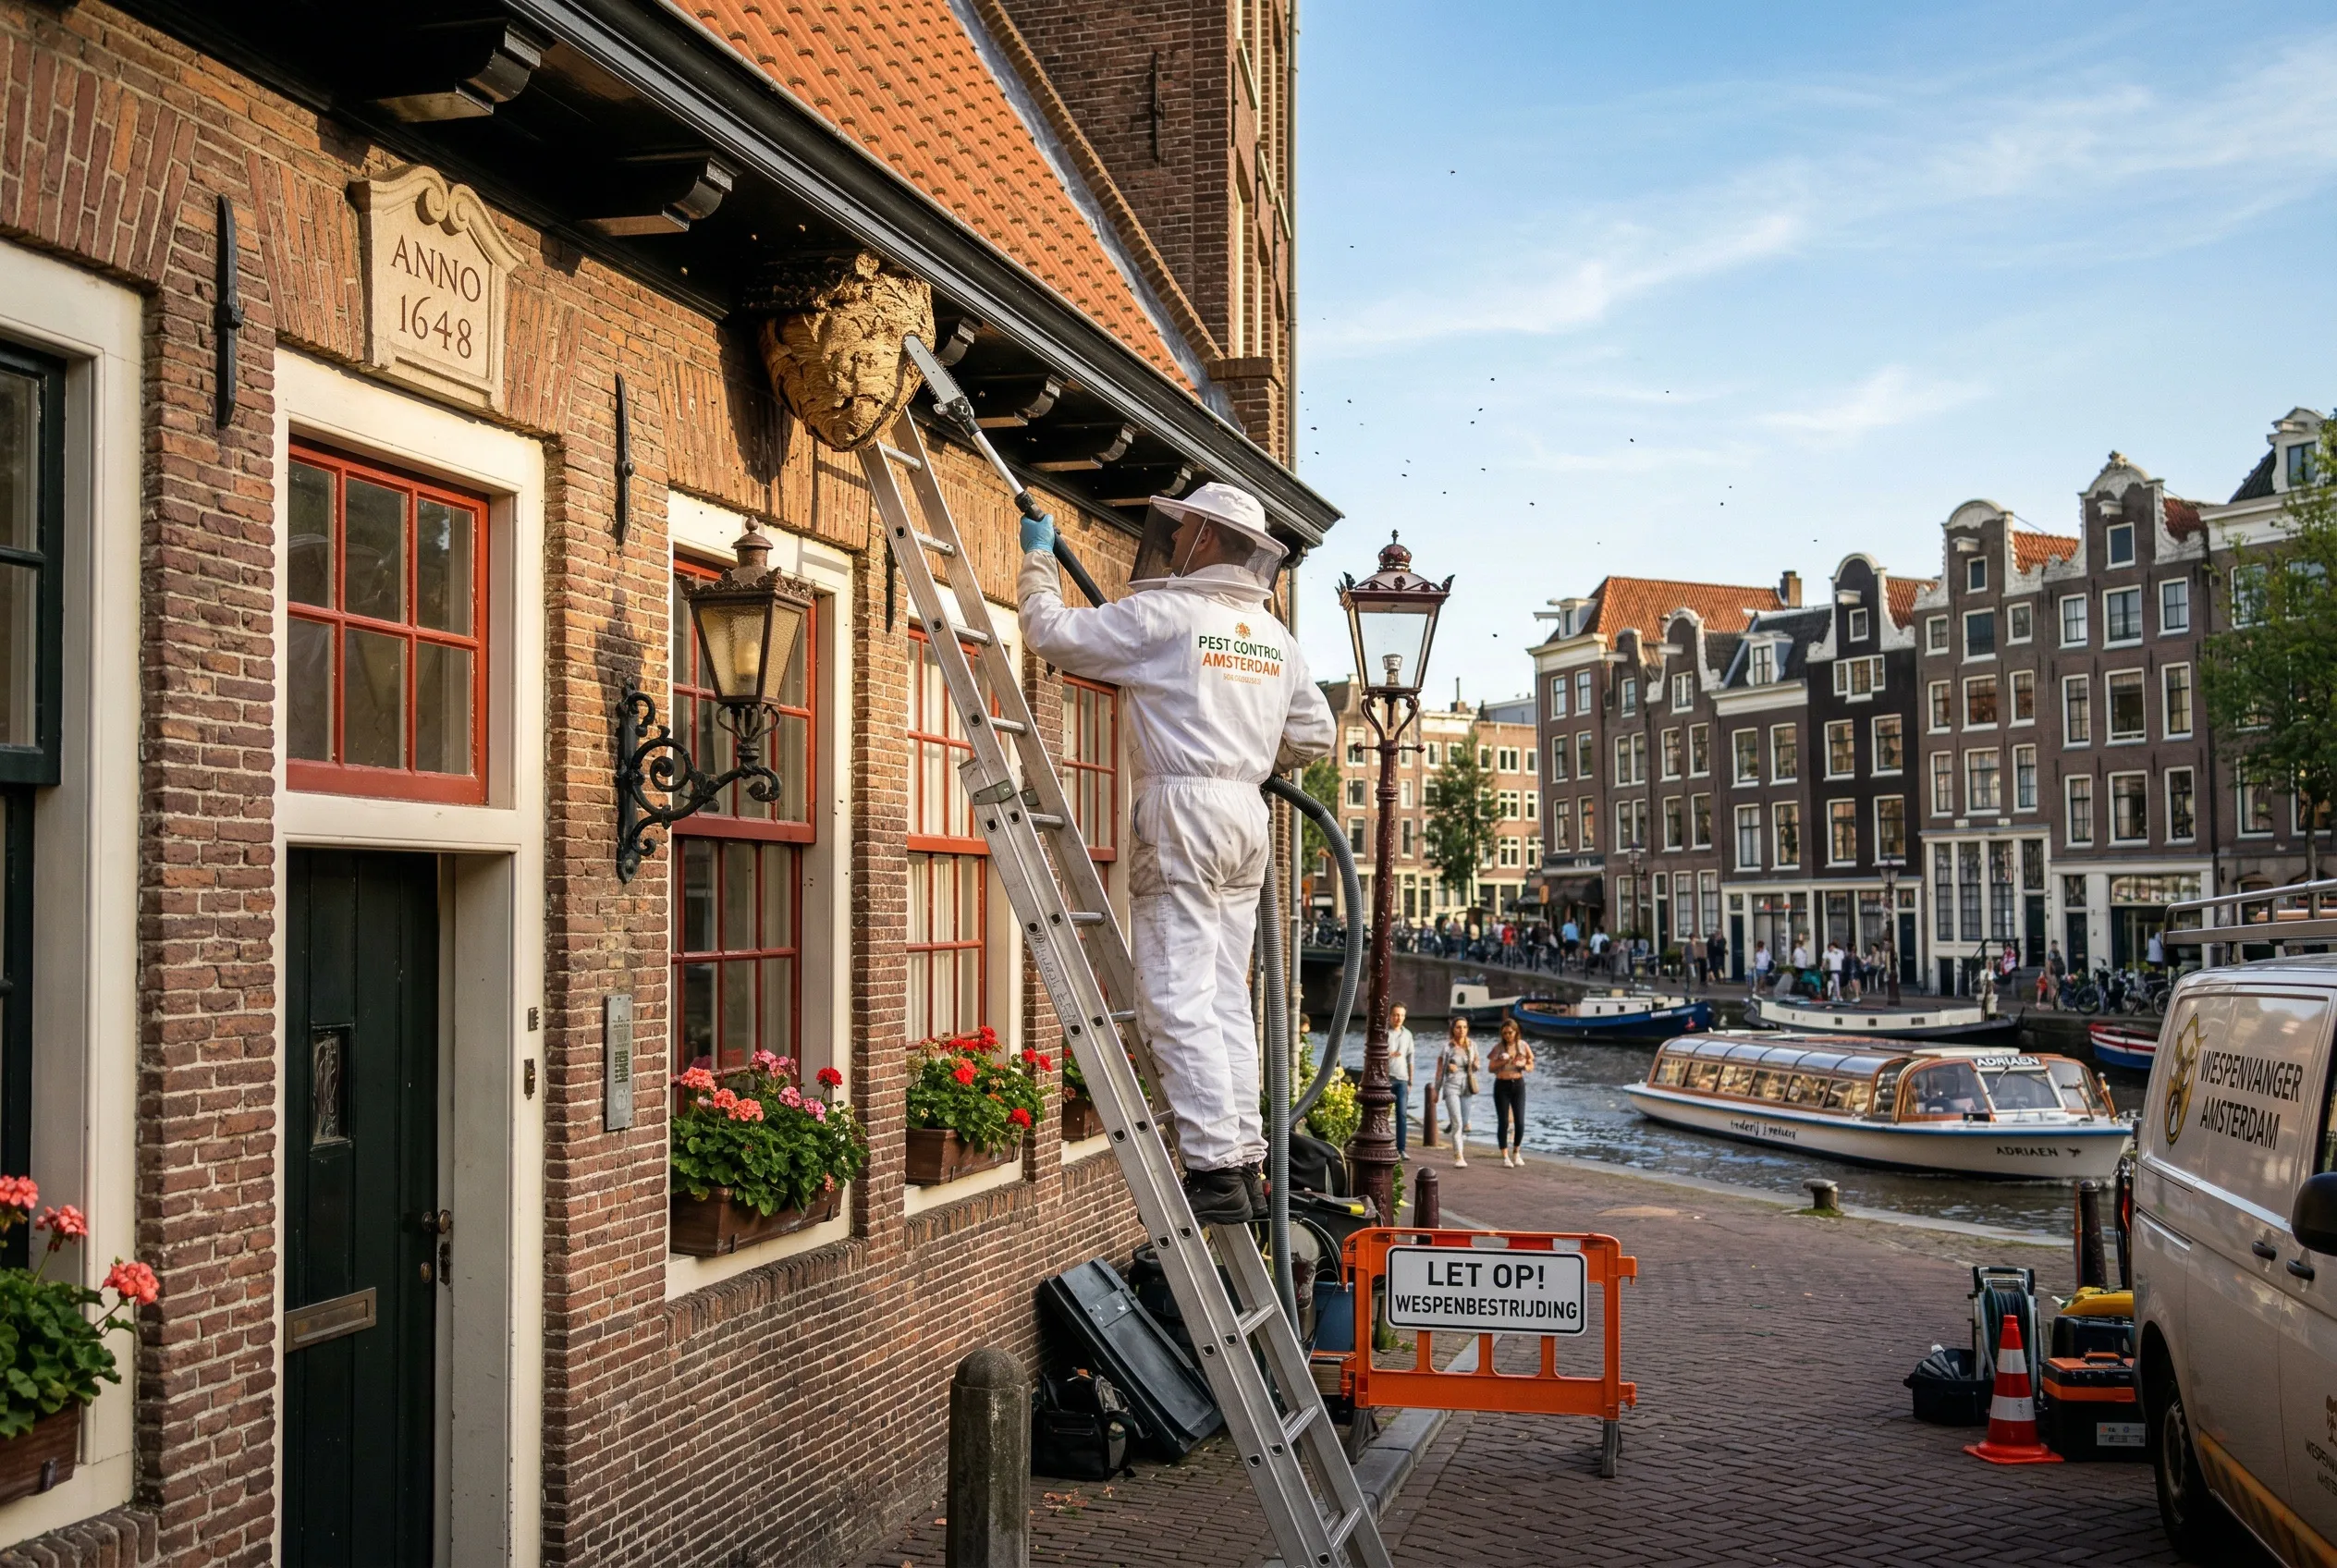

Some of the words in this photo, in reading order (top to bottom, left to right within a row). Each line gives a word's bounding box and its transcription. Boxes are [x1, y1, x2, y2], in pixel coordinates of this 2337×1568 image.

[391, 235, 482, 302] ANNO
[398, 294, 472, 360] 1648
[1199, 636, 1230, 651] PEST
[1234, 641, 1283, 661] CONTROL
[1202, 652, 1280, 677] AMSTERDAM
[2200, 1050, 2303, 1103] WESPENVANGER
[2200, 1096, 2281, 1150] AMSTERDAM
[1997, 1146, 2059, 1157] ADRIAEN
[1427, 1261, 1482, 1287] LET
[1493, 1264, 1545, 1290] OP!
[1395, 1294, 1578, 1319] WESPENBESTRIJDING
